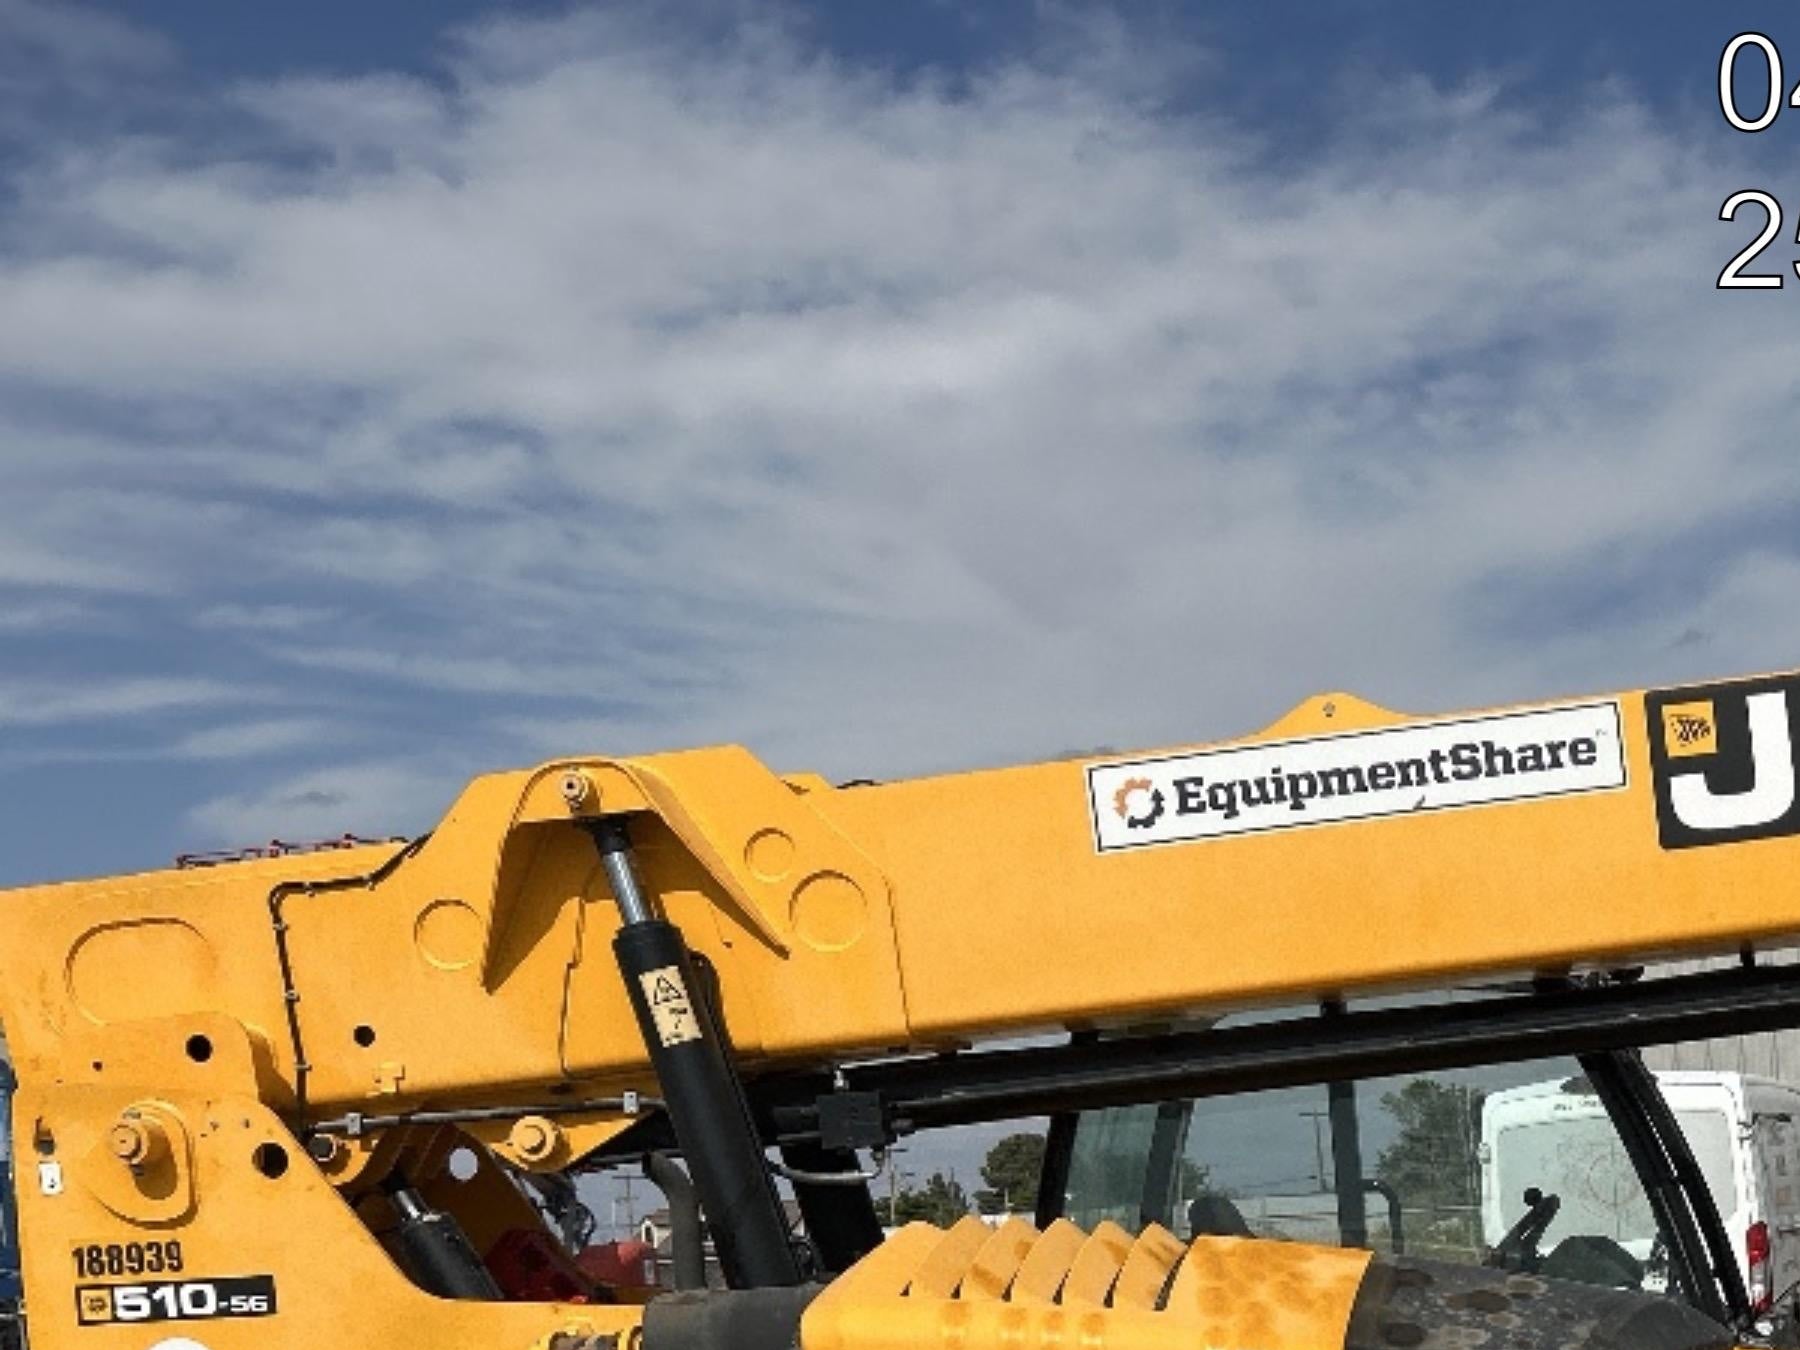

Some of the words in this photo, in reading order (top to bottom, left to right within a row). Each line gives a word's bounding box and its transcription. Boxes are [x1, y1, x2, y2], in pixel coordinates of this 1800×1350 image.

[1173, 736, 1599, 819] EquipmentShare
[72, 1239, 184, 1278] 188939
[113, 1282, 269, 1320] 510-56
